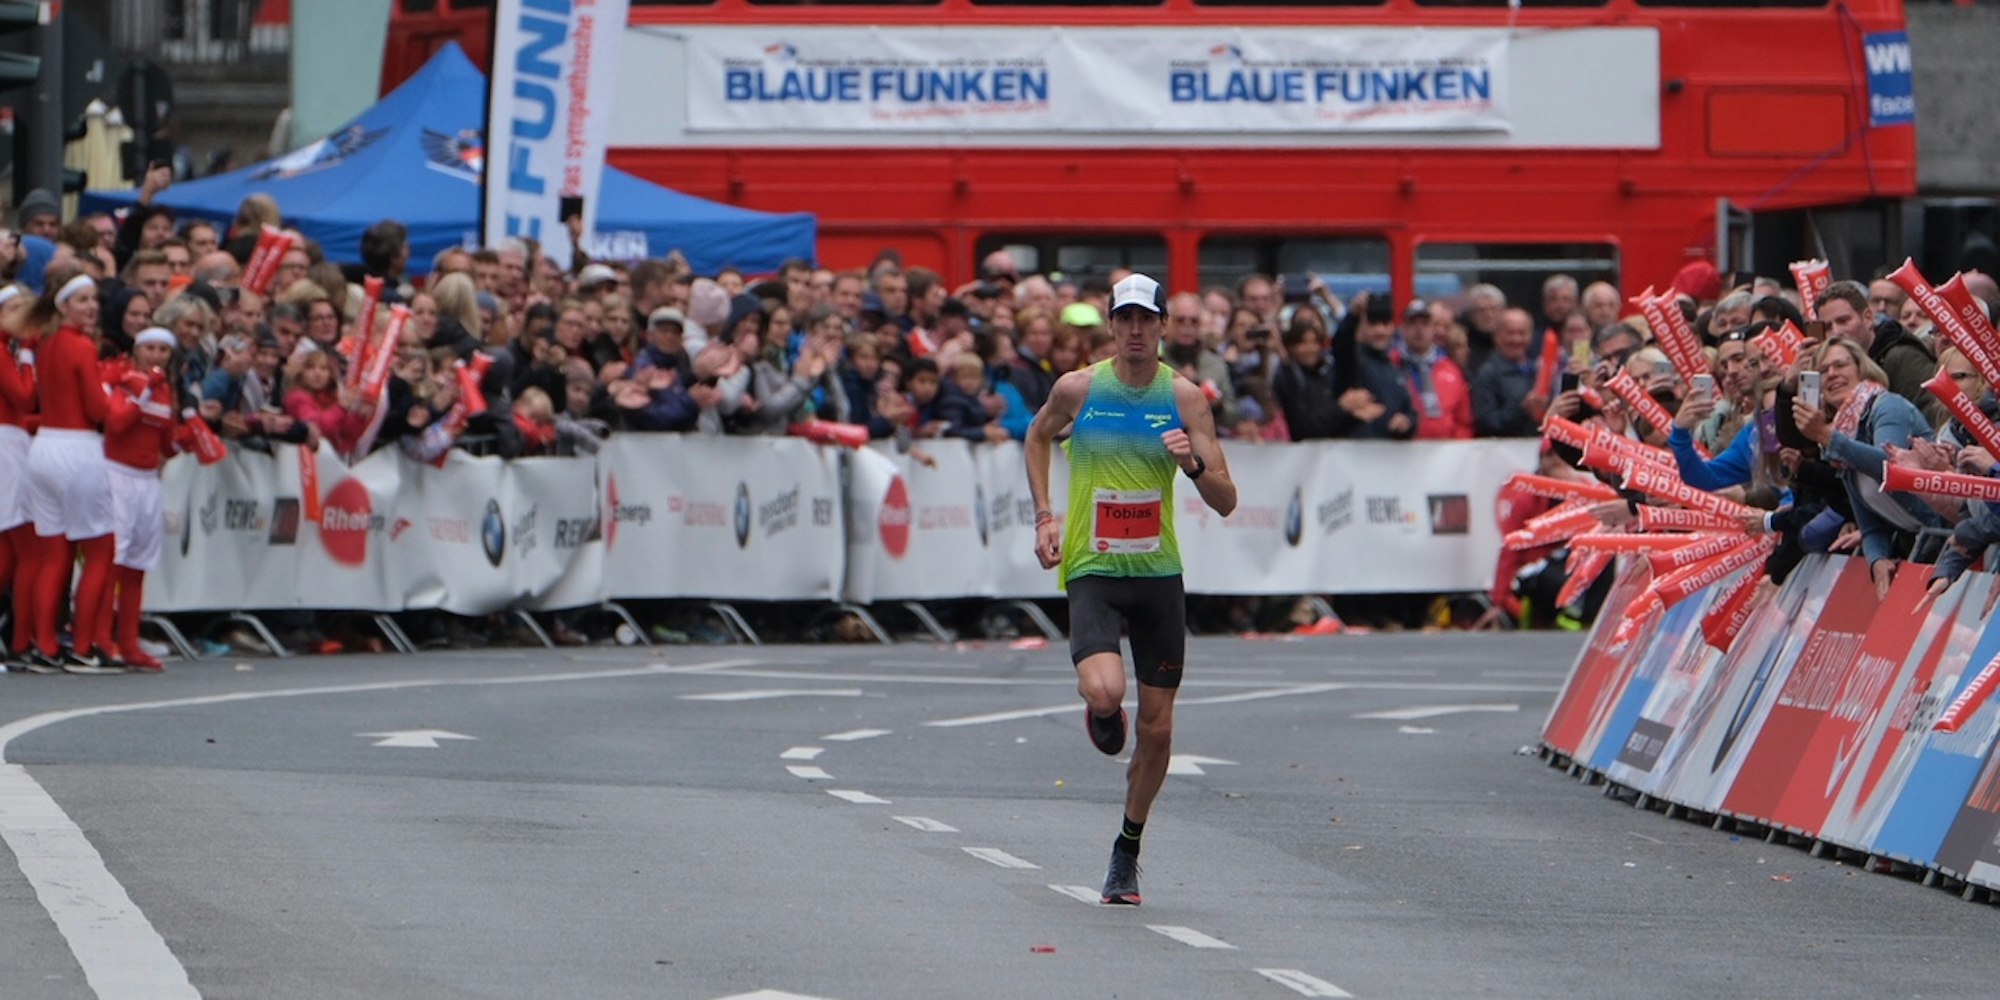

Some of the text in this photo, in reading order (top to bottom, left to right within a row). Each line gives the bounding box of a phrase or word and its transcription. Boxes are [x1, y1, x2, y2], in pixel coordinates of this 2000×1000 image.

[508, 0, 572, 195] FUN
[726, 69, 1047, 102] BLAUE FUNKEN
[1170, 69, 1489, 102] BLAUE FUNKEN
[1103, 505, 1153, 519] Tobias
[1125, 527, 1131, 536] 1
